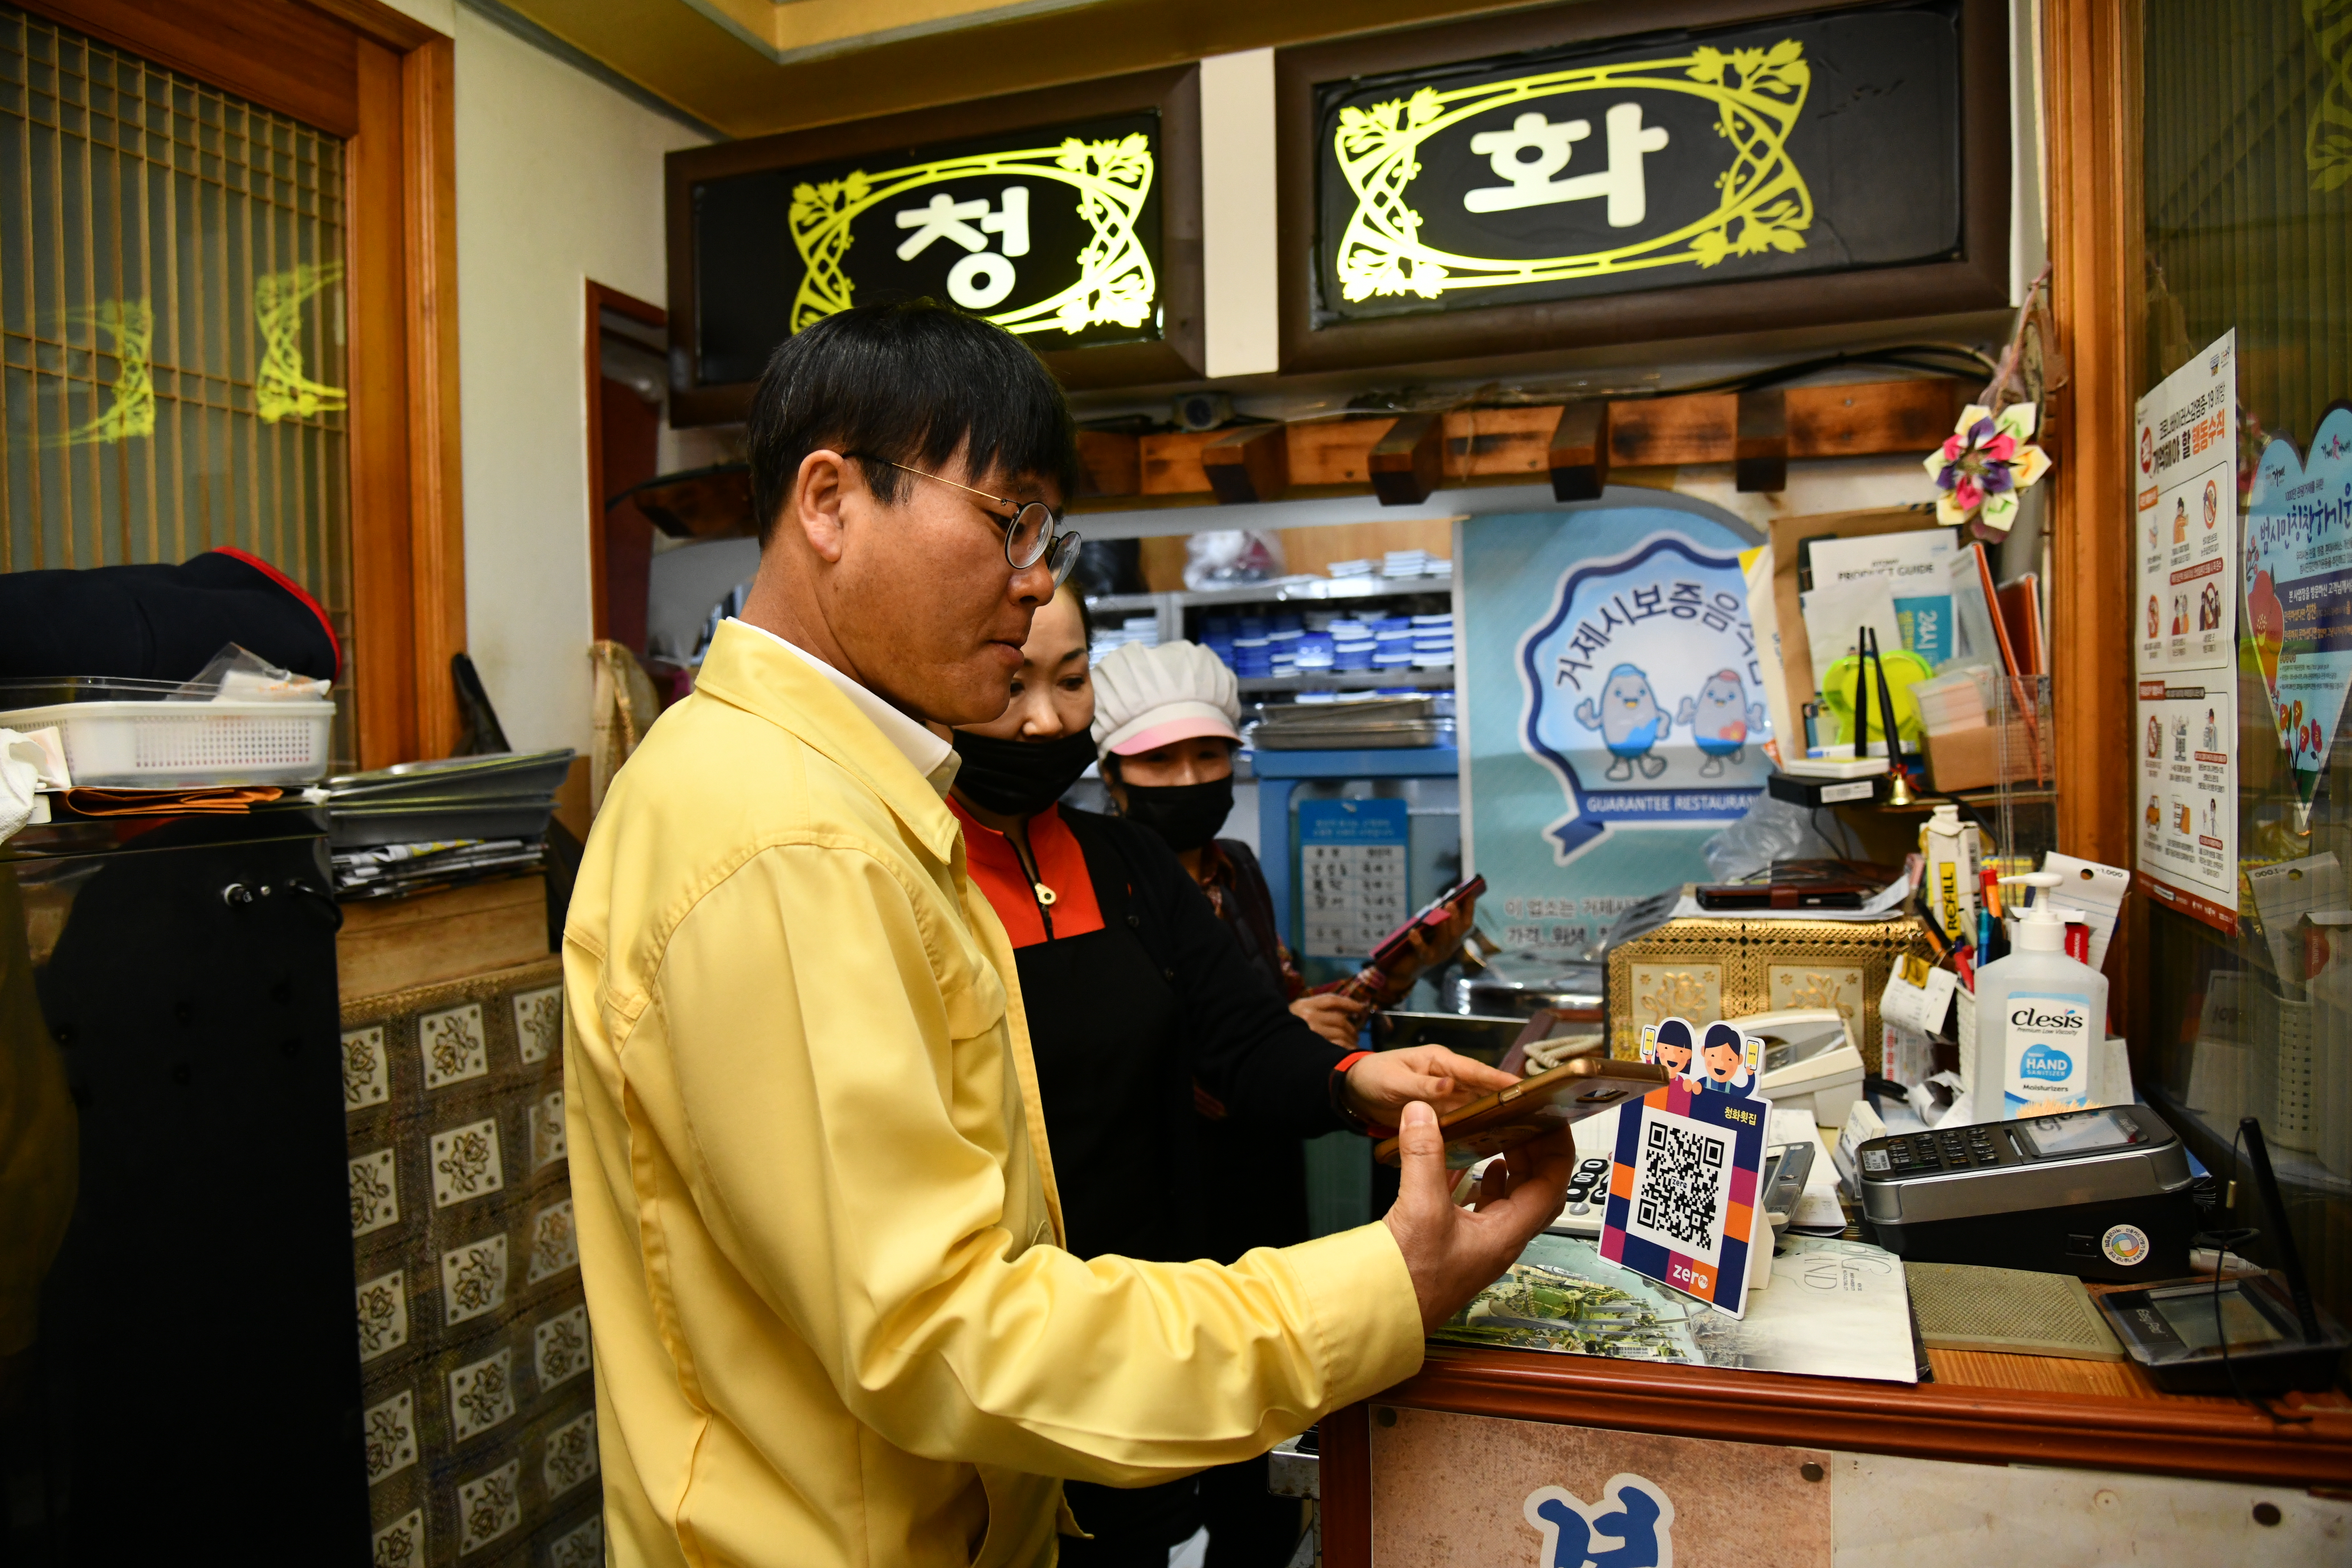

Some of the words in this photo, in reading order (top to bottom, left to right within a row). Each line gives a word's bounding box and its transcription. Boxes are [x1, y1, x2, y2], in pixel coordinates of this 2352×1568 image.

[896, 186, 1030, 310] 청
[1464, 102, 1669, 228] 화
[2182, 430, 2191, 459] 할
[2192, 409, 2225, 455] 행동수칙
[1896, 564, 1934, 577] GUIDE
[2293, 586, 2310, 602] 사업장을
[2310, 583, 2328, 599] 방문하신
[1586, 795, 1671, 812] GUARANTEE
[1505, 899, 1522, 919] 이
[1942, 872, 1958, 931] REFILL
[2027, 1058, 2068, 1071] HAND
[1724, 1106, 1757, 1126] 청화횟집
[2126, 1228, 2141, 1238] 신용카드
[1804, 1239, 1838, 1289] ISLAND
[1840, 1242, 1892, 1275] BIG
[1700, 1277, 1708, 1285] Pay
